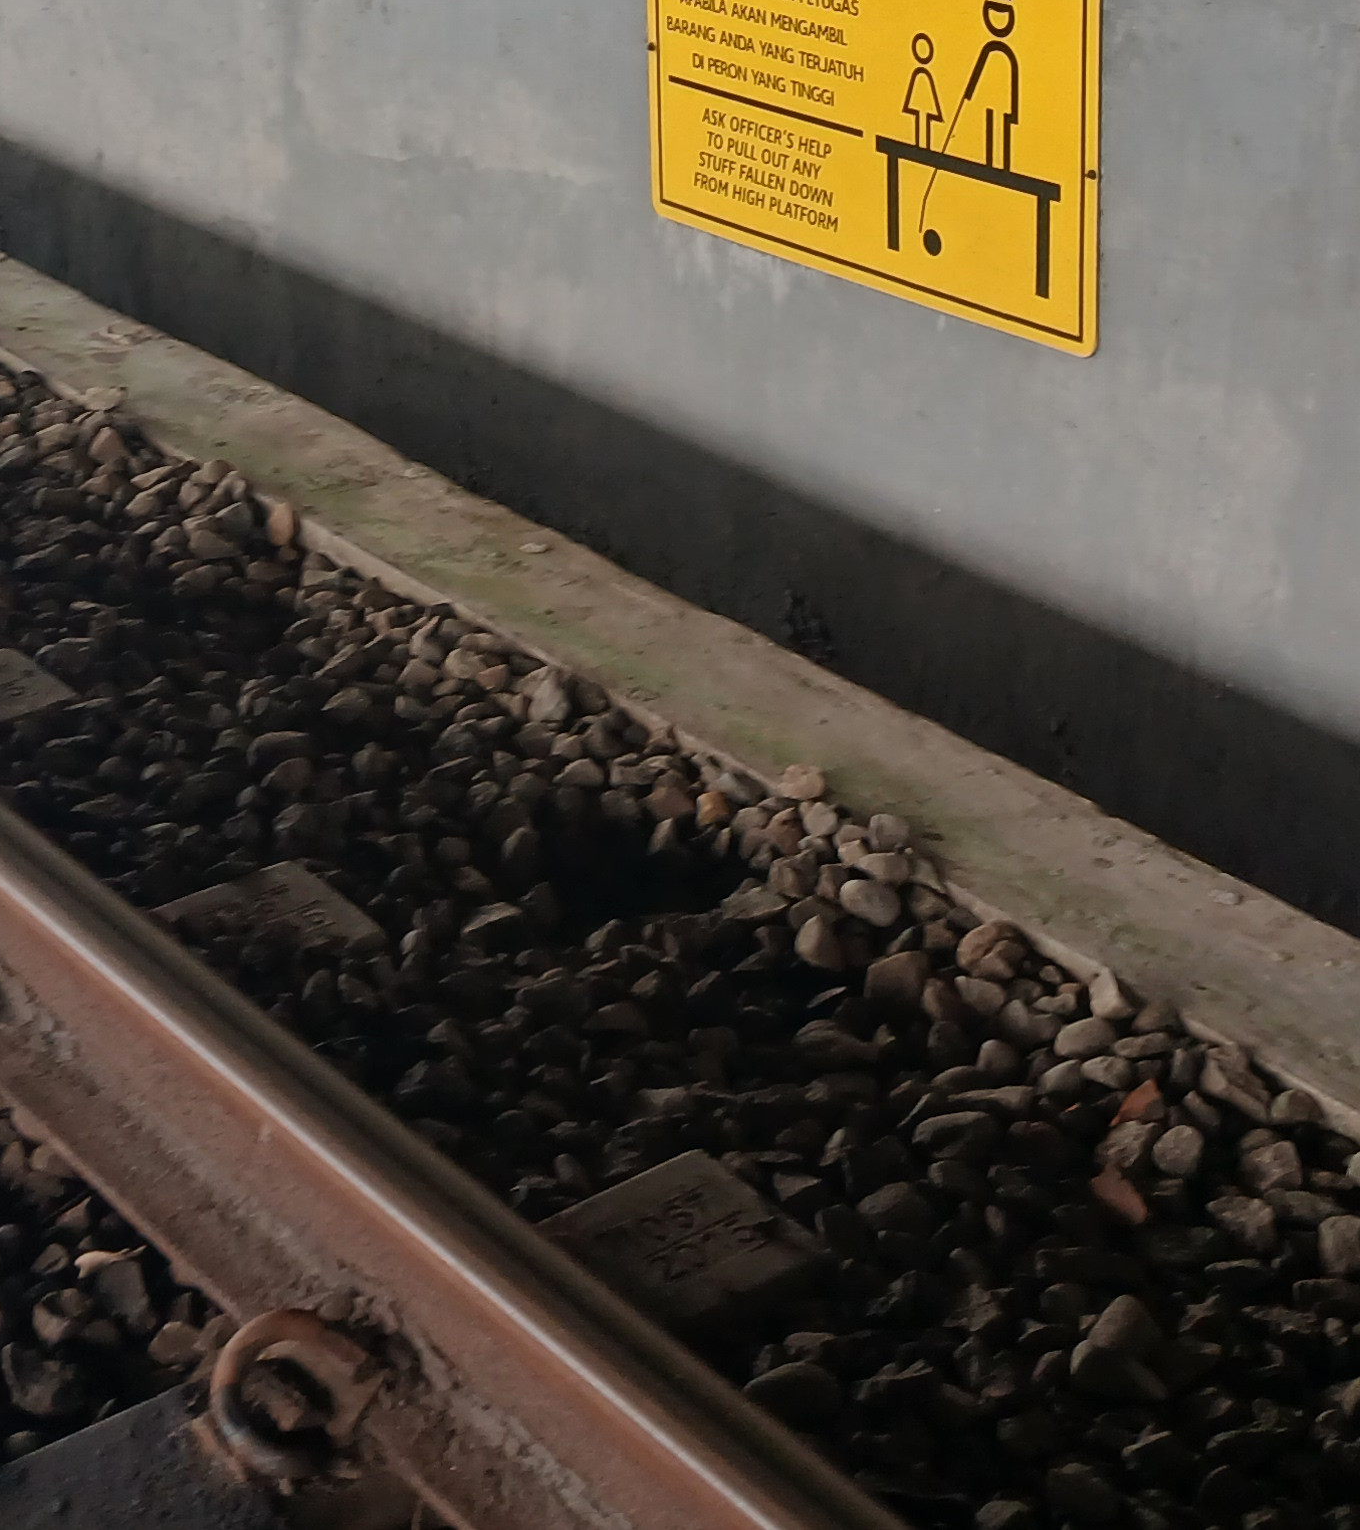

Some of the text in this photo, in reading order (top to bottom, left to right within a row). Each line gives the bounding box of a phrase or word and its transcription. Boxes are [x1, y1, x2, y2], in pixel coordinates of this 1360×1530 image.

[666, 16, 864, 82] BARANG ANDA YANG TERJATUH
[731, 3, 766, 26] AKAN
[770, 12, 848, 46] MENGAMBIL
[692, 53, 834, 106] DI PERON YANG TINGGI
[702, 107, 832, 159] ASK OFFICER'S HELP
[707, 131, 822, 180] TO PULL OUT ANY
[693, 171, 839, 233] FROM HIGH PLATFORM
[698, 151, 834, 207] STUFF FALLEN DOWN
